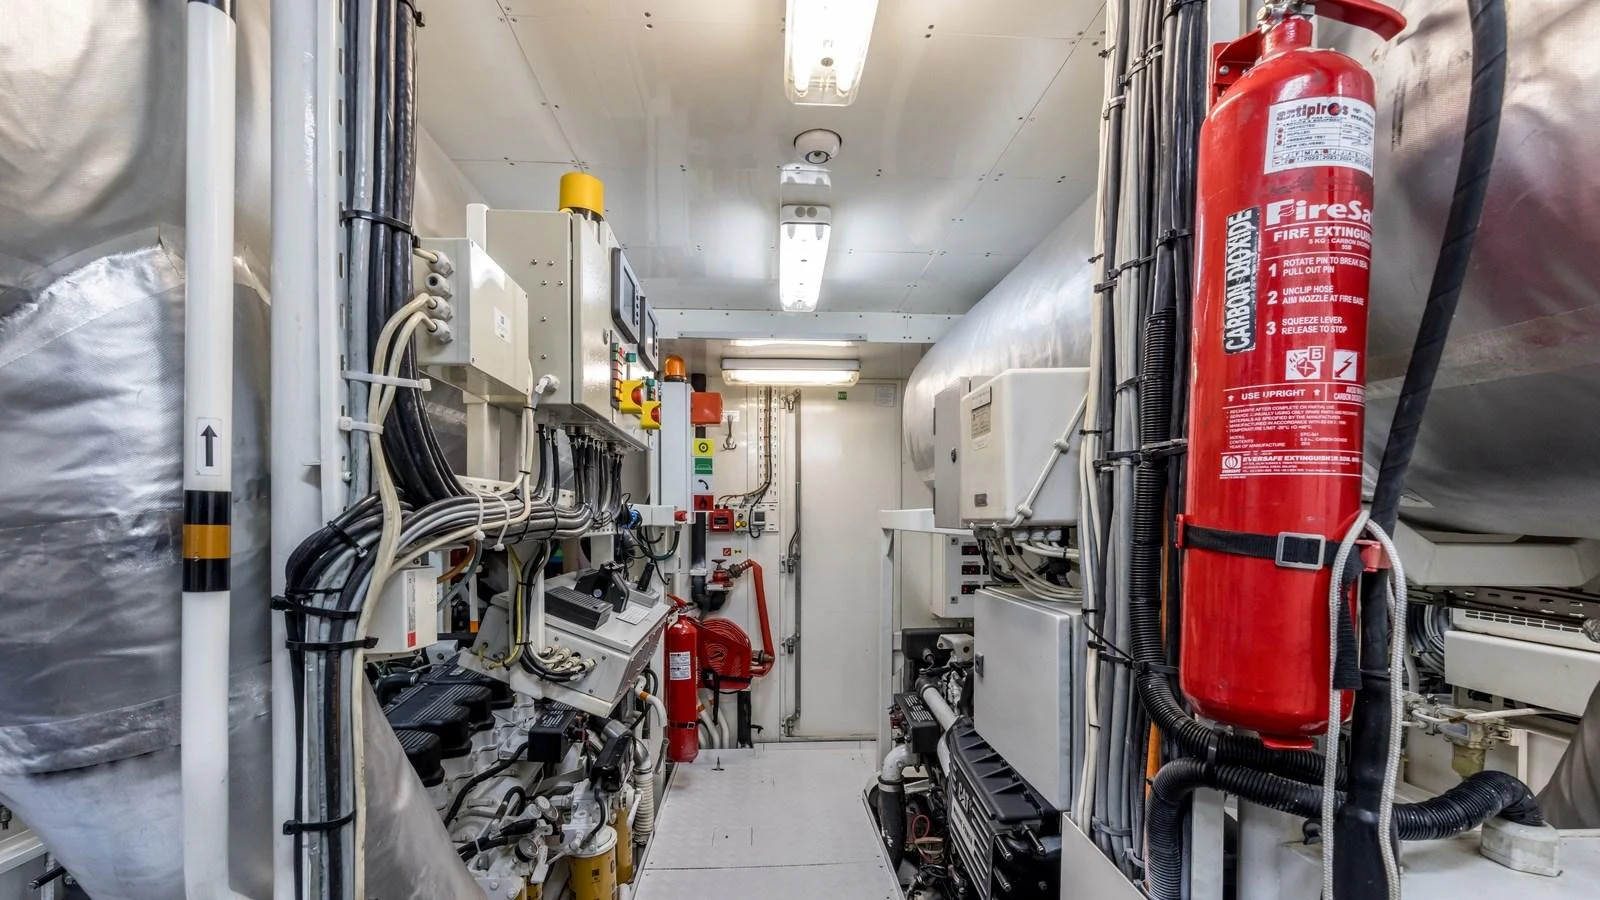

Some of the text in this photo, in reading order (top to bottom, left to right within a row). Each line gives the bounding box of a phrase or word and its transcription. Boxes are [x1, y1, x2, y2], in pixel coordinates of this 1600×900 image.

[1266, 199, 1372, 226] FireSa
[1273, 227, 1310, 242] FIRE
[1283, 257, 1315, 268] ROTATE
[1315, 256, 1329, 265] PIN
[1329, 256, 1339, 265] TO
[1340, 256, 1359, 266] BREAK
[1268, 263, 1277, 277] 1
[1282, 265, 1335, 277] PULL OUT PIN
[1282, 285, 1334, 296] UNCLIP HOSE
[1267, 290, 1278, 305] 2
[1282, 296, 1298, 305] AIM
[1298, 294, 1329, 304] NOZZLE
[1329, 294, 1339, 303] AT
[1339, 295, 1352, 304] FIRE
[1281, 316, 1343, 327] SQUEEZE LEVER
[1265, 321, 1277, 336] 3
[1281, 325, 1348, 336] RELEASE TO STOP
[1241, 389, 1306, 401] USE UPRIGHT
